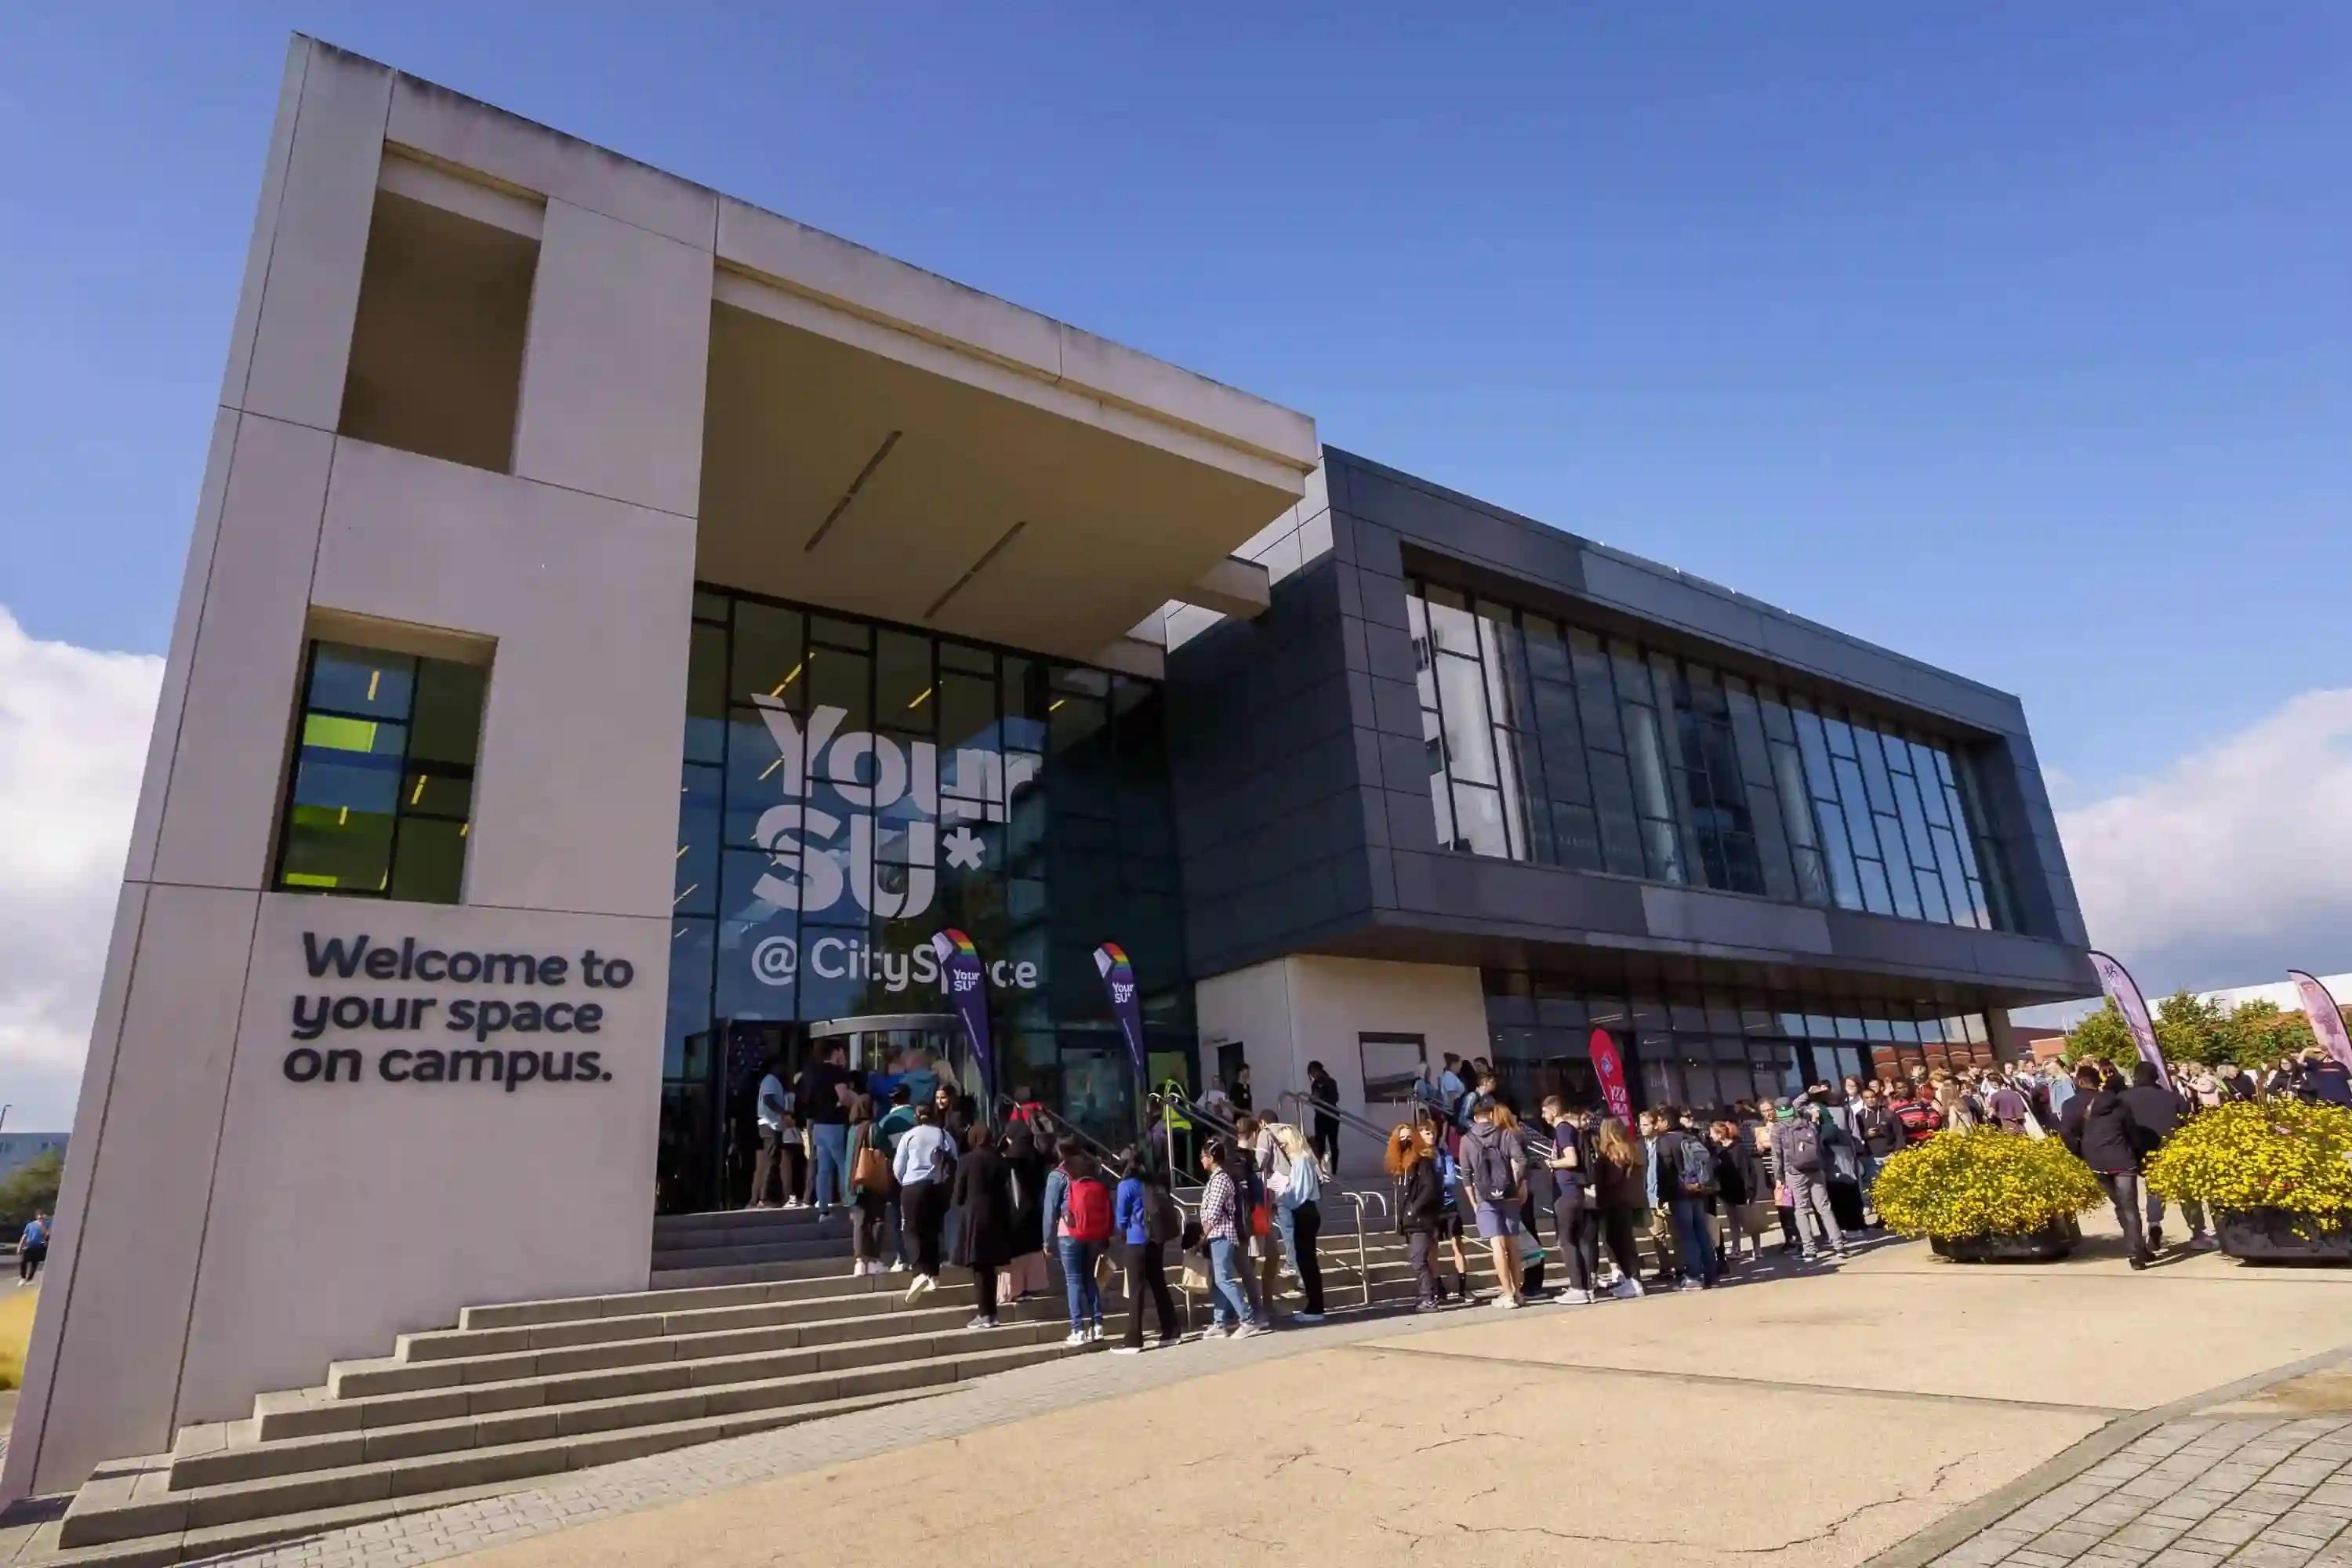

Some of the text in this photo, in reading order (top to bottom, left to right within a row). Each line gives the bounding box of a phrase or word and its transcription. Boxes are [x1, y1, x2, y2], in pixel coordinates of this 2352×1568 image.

[750, 694, 1041, 823] Your
[303, 931, 634, 989] Welcome to
[811, 937, 1037, 995] CitySce
[953, 968, 980, 980] Your
[1112, 982, 1134, 993] Your
[291, 995, 603, 1042] your space
[283, 1047, 613, 1093] on campus.
